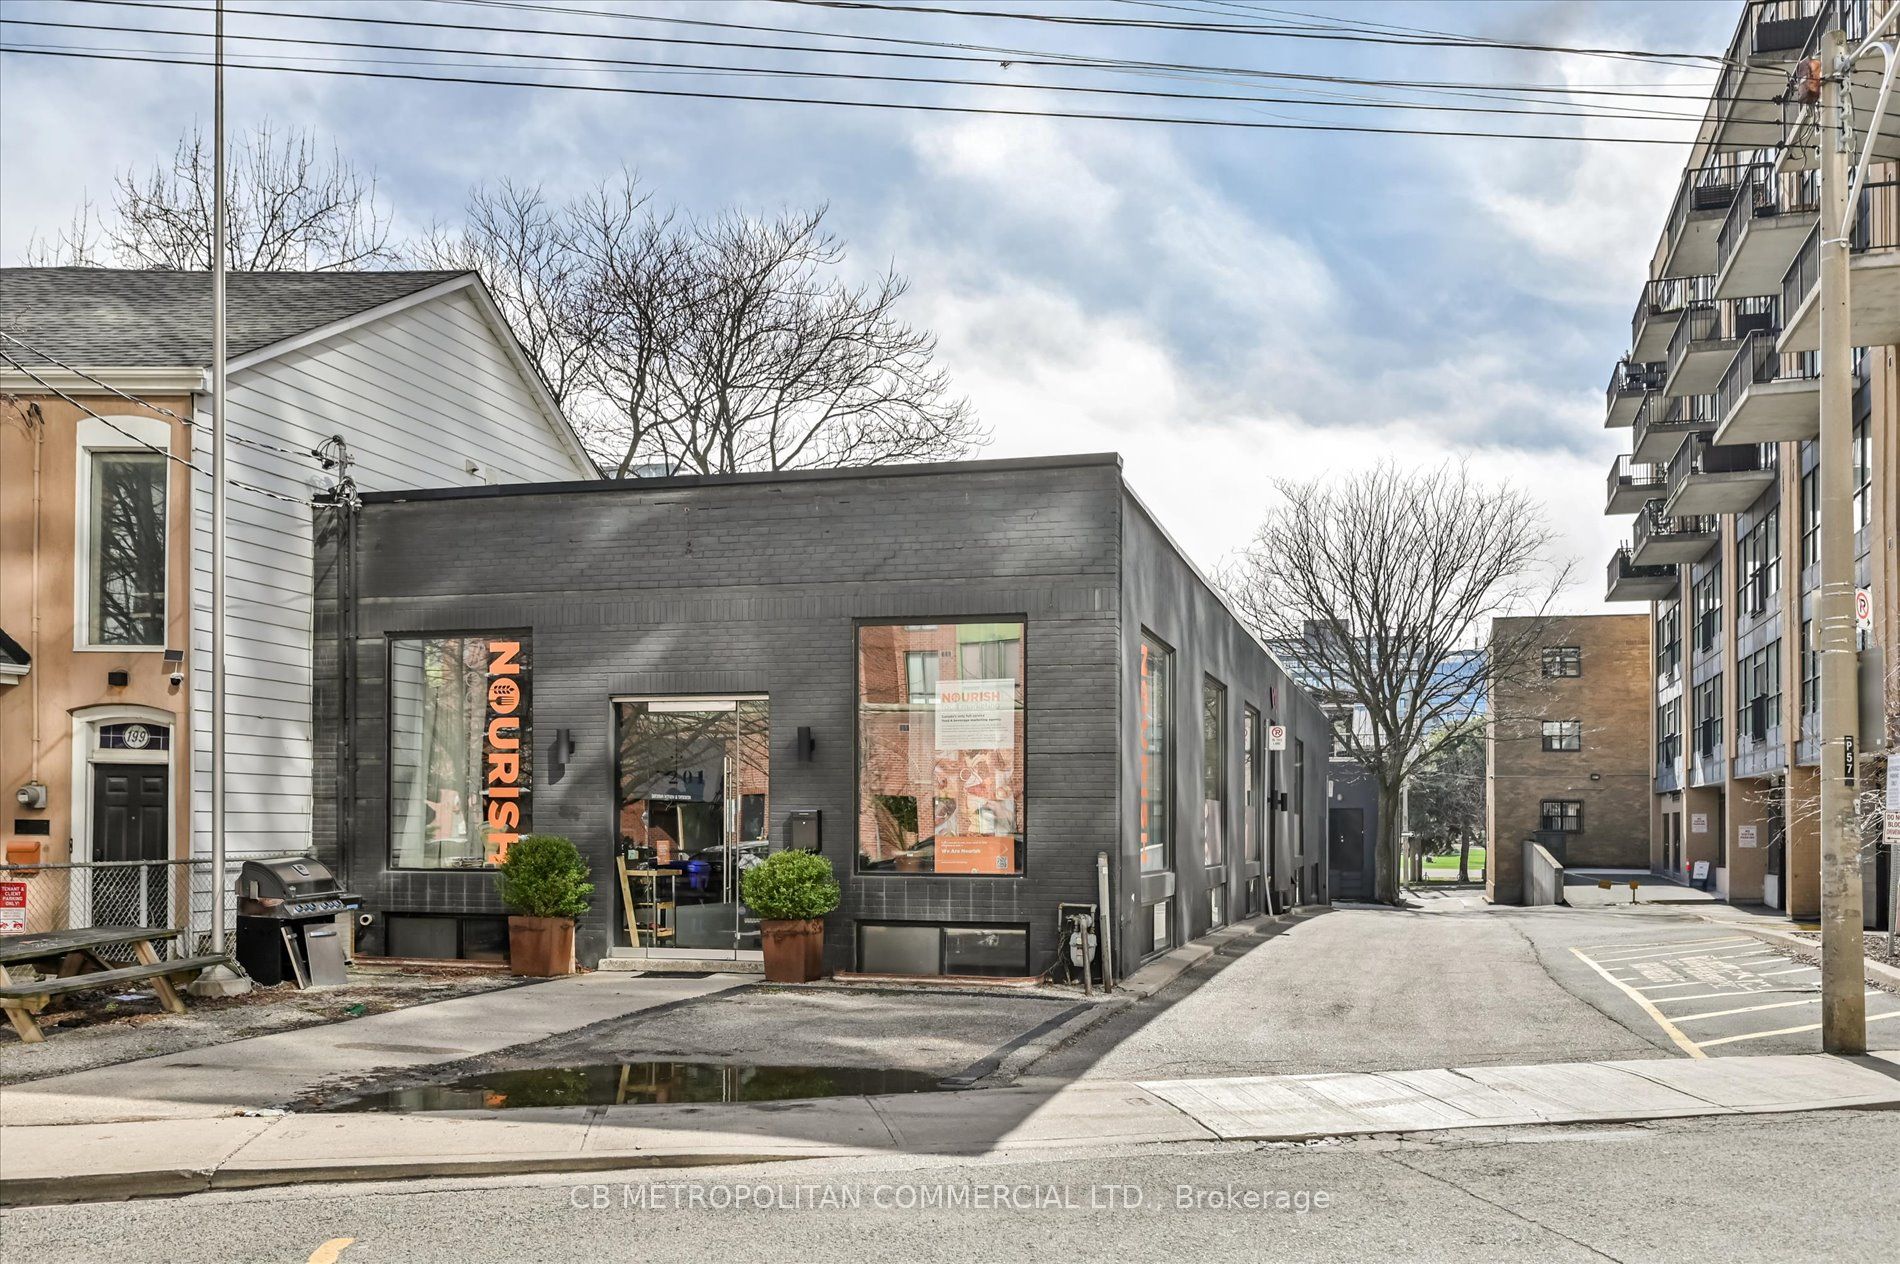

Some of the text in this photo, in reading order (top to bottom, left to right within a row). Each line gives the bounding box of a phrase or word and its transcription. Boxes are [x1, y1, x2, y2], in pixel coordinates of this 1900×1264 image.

[942, 691, 1000, 703] NOURISH
[126, 730, 146, 743] 199
[488, 642, 520, 864] NOURISH
